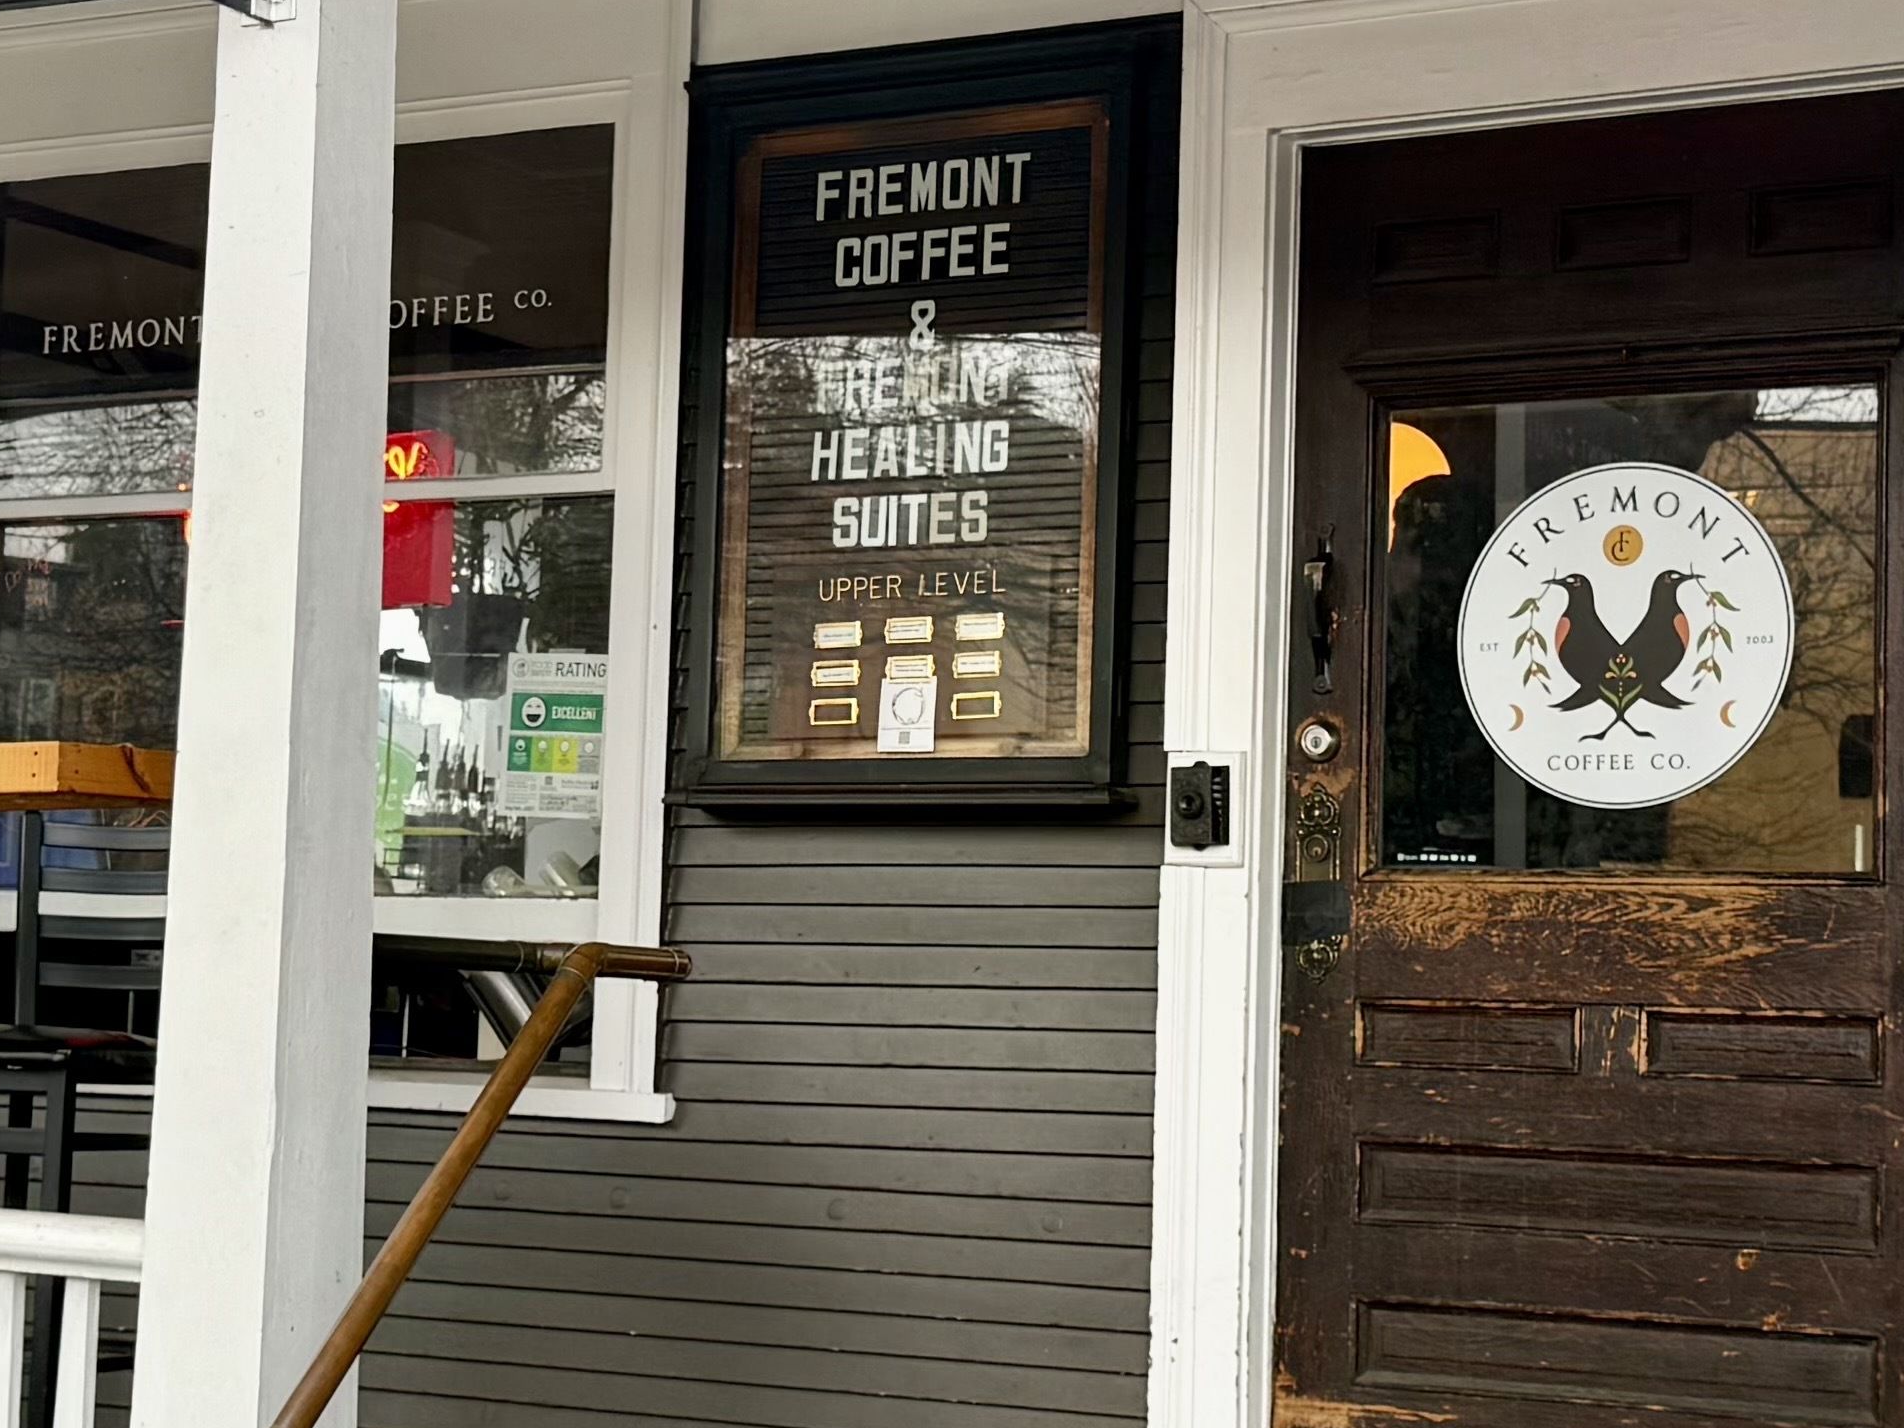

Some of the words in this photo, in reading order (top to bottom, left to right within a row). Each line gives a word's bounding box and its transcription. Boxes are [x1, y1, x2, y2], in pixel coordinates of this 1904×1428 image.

[815, 152, 1031, 222] FREMONT
[835, 222, 1010, 288] COFFEE
[42, 315, 203, 354] FREMONT
[390, 293, 495, 329] OFFEE
[513, 288, 553, 309] CO.
[910, 300, 936, 350] &
[811, 420, 1010, 482] HEALING
[832, 490, 989, 549] SUITES
[1507, 486, 1750, 568] FREMONT
[819, 575, 902, 602] UPPER
[918, 569, 1006, 596] LEVEL
[555, 661, 607, 678] RATING
[1547, 754, 1636, 772] COFFEE
[1650, 753, 1691, 771] CO.
